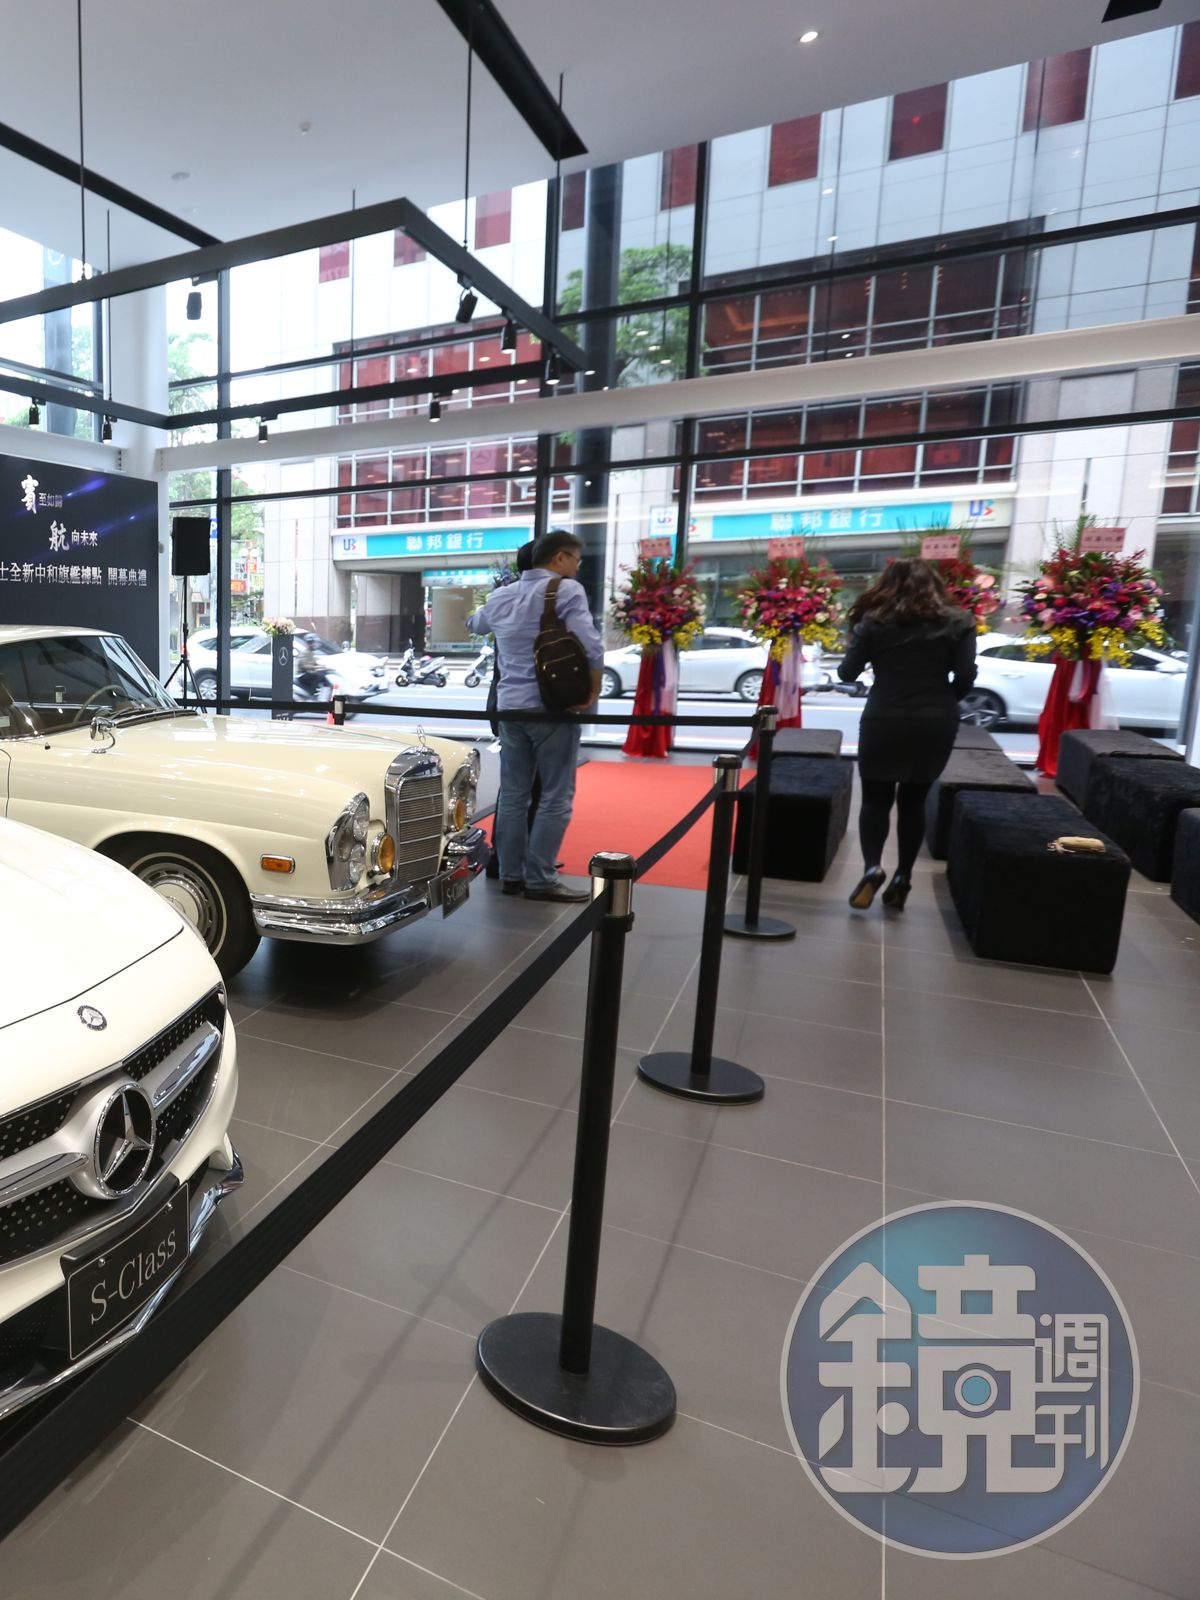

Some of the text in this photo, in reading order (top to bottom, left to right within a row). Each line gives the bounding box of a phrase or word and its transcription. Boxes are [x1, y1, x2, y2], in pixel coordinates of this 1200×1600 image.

[770, 507, 884, 530] 聯邦銀行
[406, 532, 484, 551] 聯邦銀行
[108, 567, 147, 586] 開幕典禮
[91, 1229, 176, 1325] S-Class
